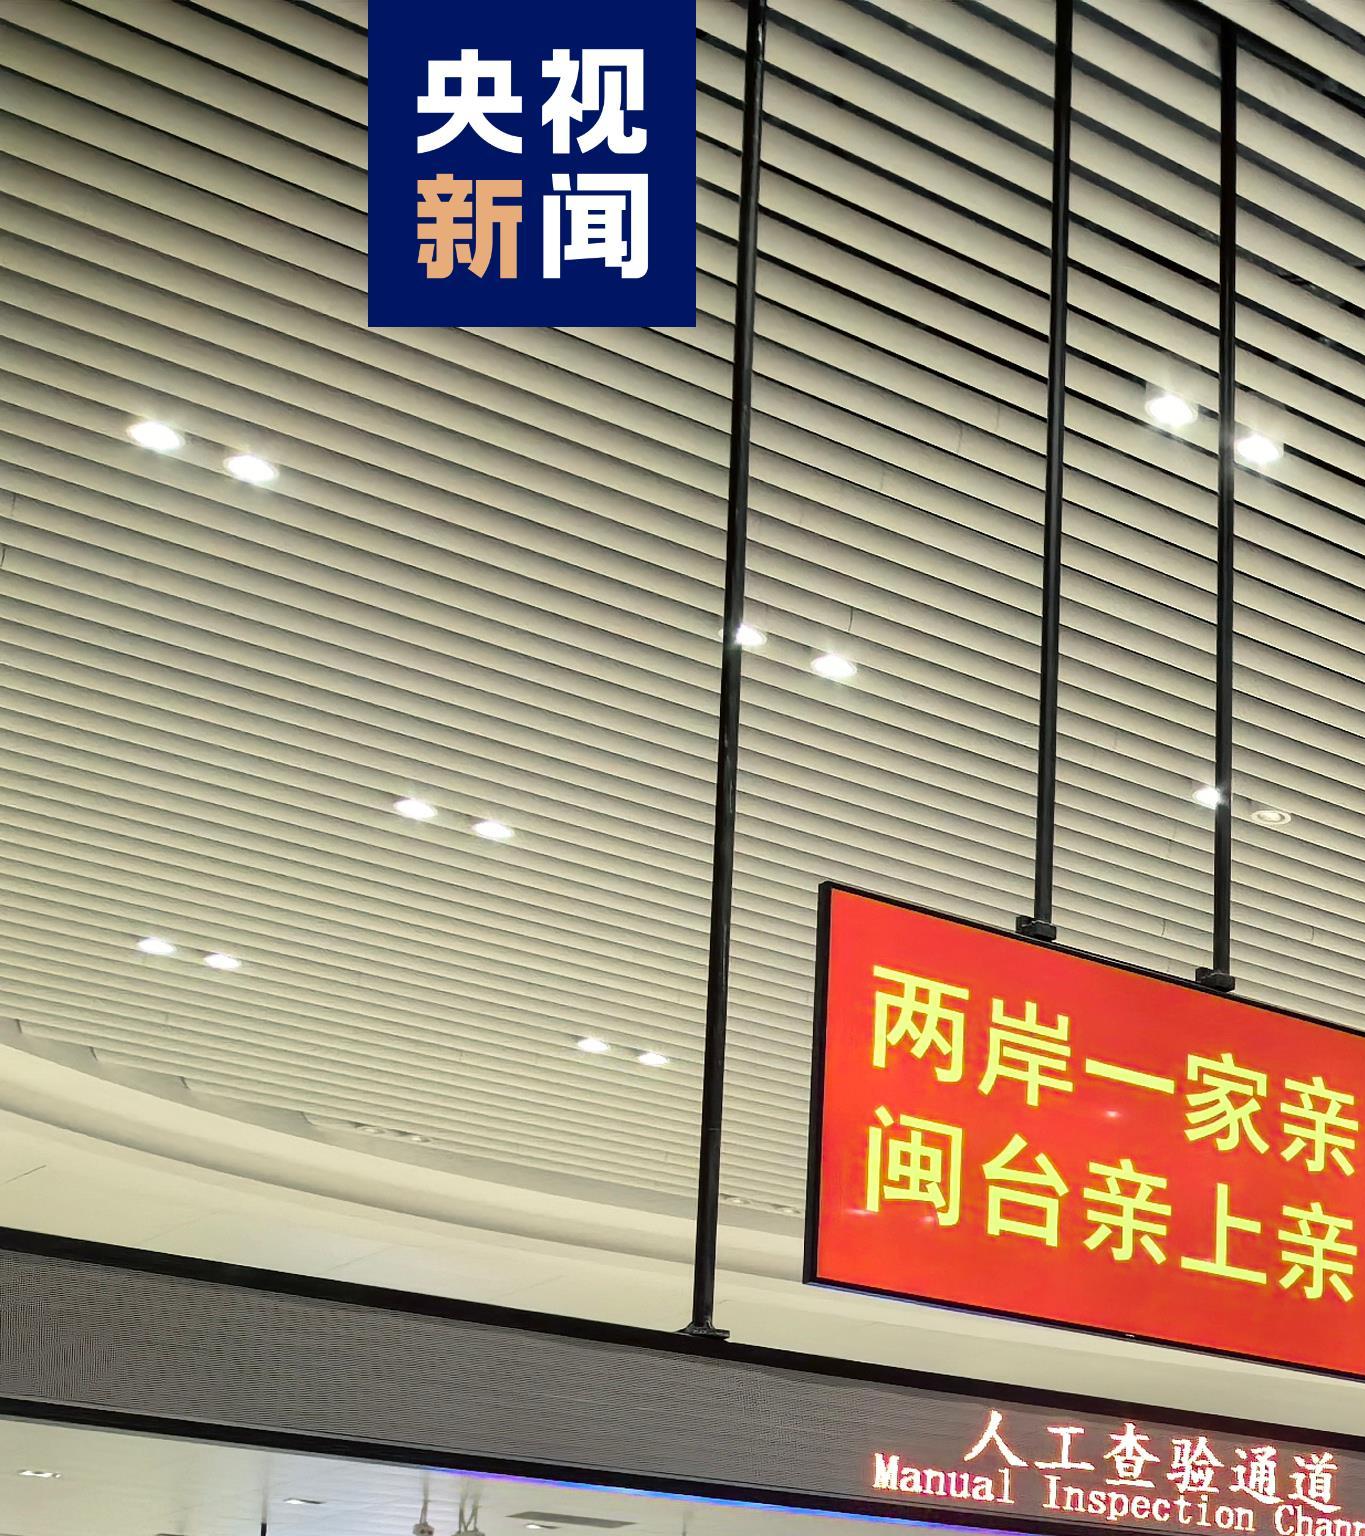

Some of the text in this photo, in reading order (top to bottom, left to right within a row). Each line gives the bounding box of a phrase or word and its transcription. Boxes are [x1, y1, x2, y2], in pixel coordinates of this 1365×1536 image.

[872, 965, 1361, 1178] 两岸一家亲
[864, 1107, 1360, 1307] 闽台亲上亲
[872, 1452, 1015, 1504] Manual
[1041, 1475, 1257, 1533] Inspection
[963, 1410, 1341, 1513] 人工查验通道
